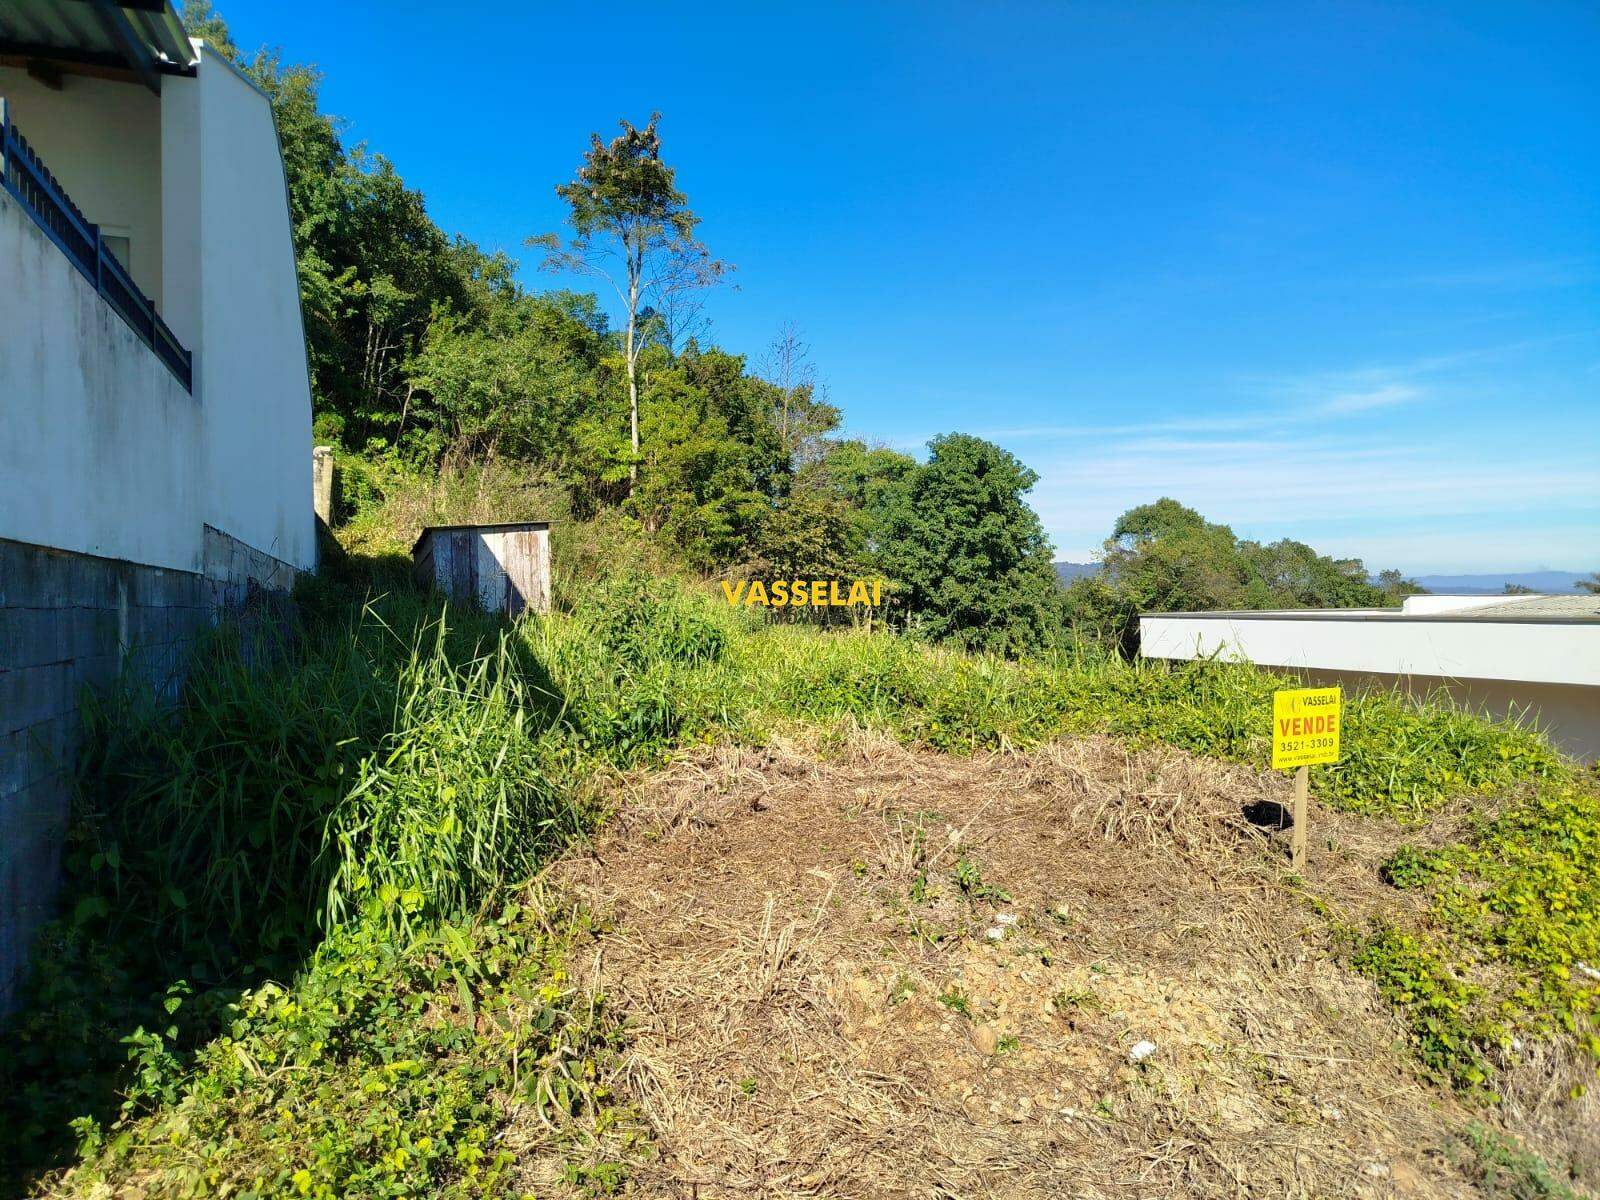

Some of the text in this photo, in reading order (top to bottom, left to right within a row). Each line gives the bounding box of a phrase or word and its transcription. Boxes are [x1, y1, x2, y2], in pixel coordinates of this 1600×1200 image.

[1302, 695, 1336, 706] VASSELAI
[1279, 714, 1336, 737] VENDE
[1280, 738, 1334, 752] 3521-3309
